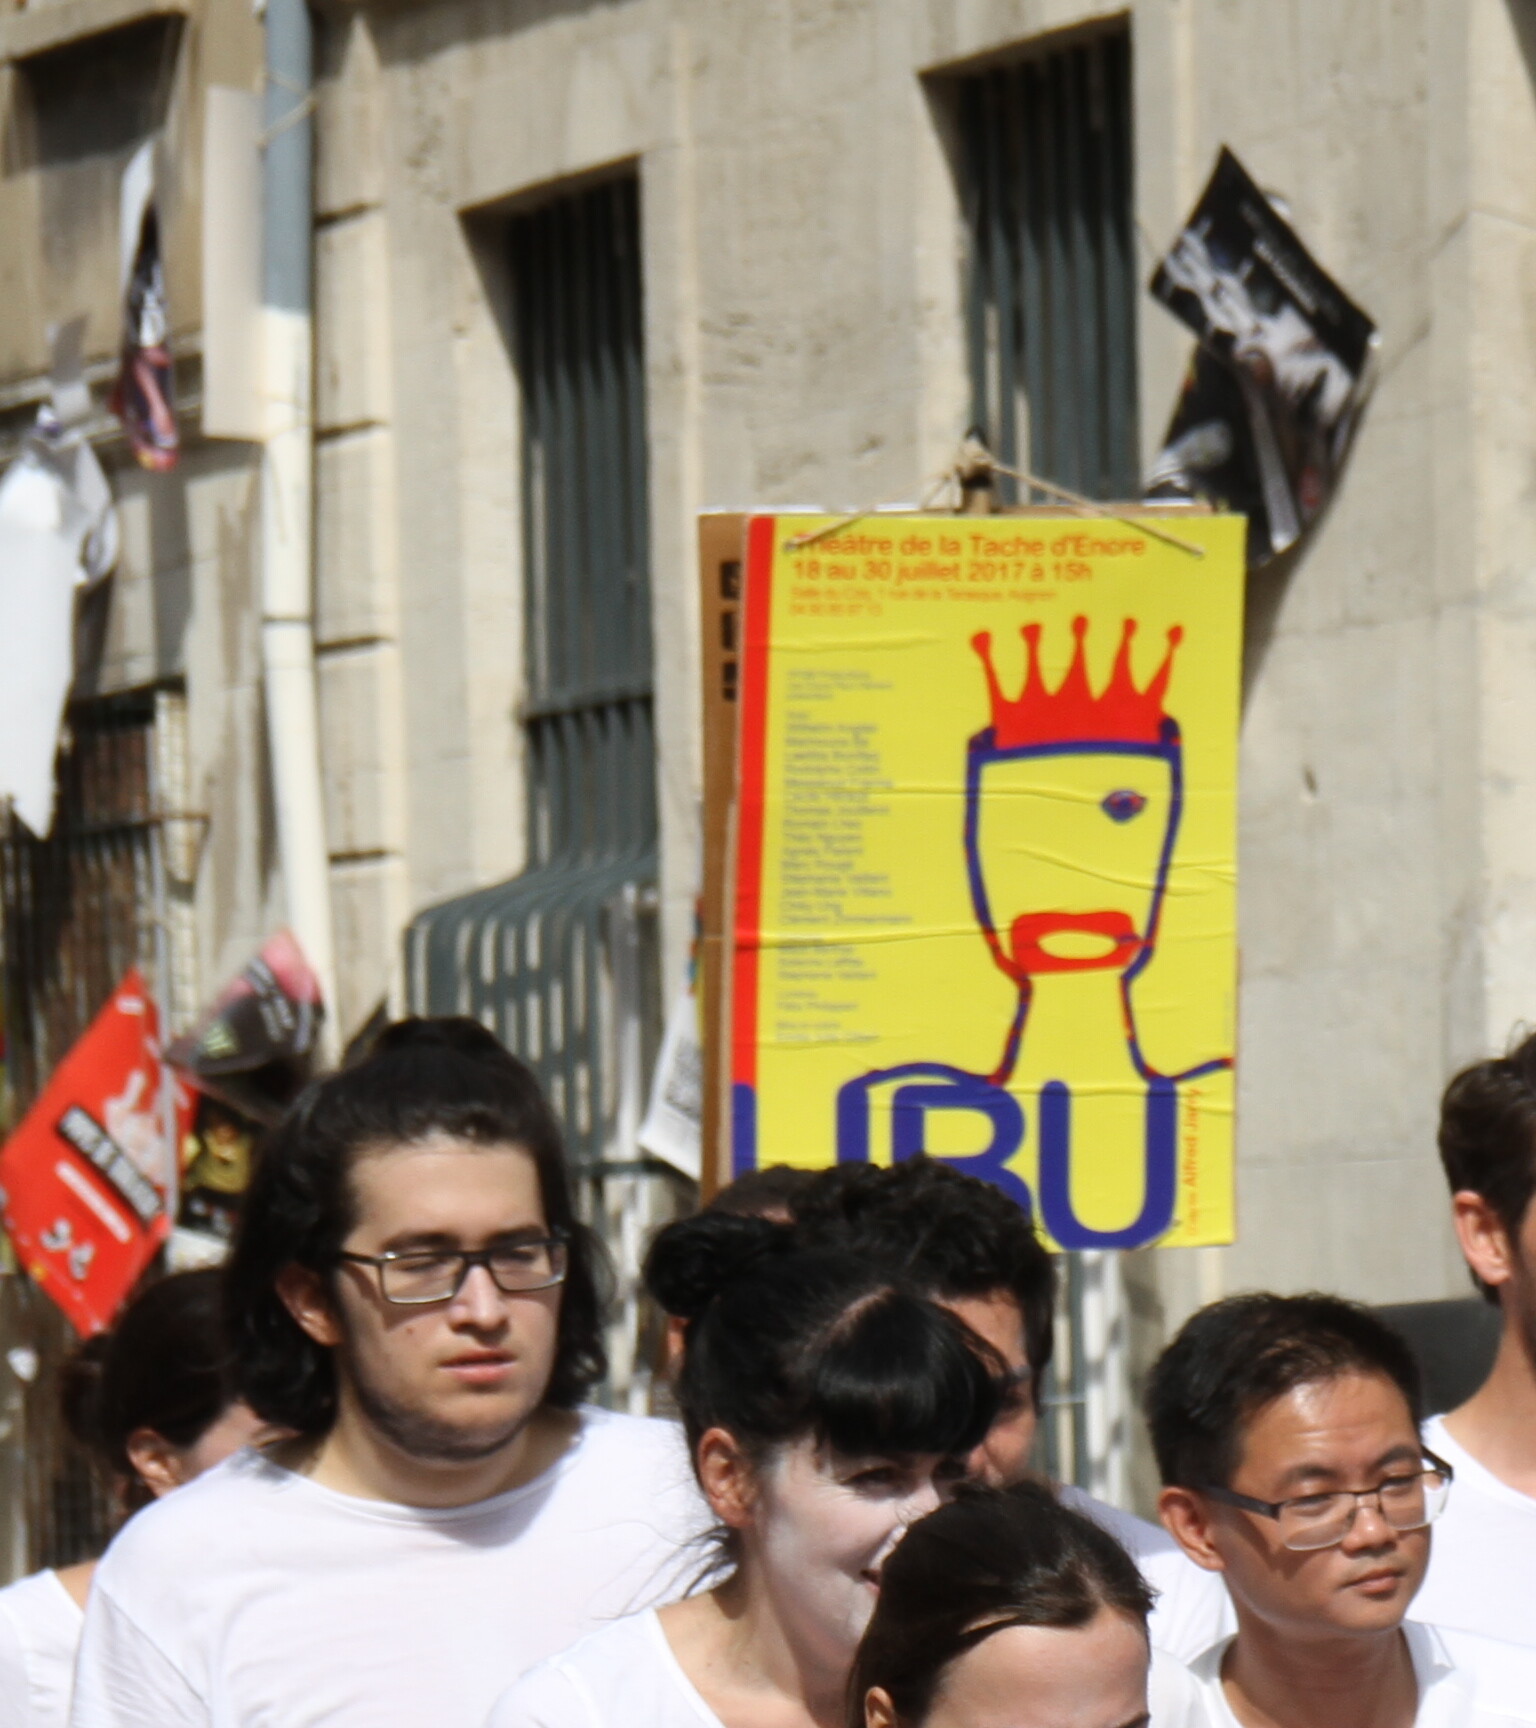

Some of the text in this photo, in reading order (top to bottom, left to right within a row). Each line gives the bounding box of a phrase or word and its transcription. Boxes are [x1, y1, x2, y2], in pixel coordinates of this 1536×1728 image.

[900, 535, 932, 556] de
[940, 535, 961, 554] la
[969, 535, 1044, 556] Tache
[795, 561, 821, 580] 18
[827, 565, 855, 581] au
[862, 561, 892, 581] 30
[896, 561, 961, 586] juillet
[969, 561, 1025, 582] 2017
[1053, 561, 1093, 581] 15h
